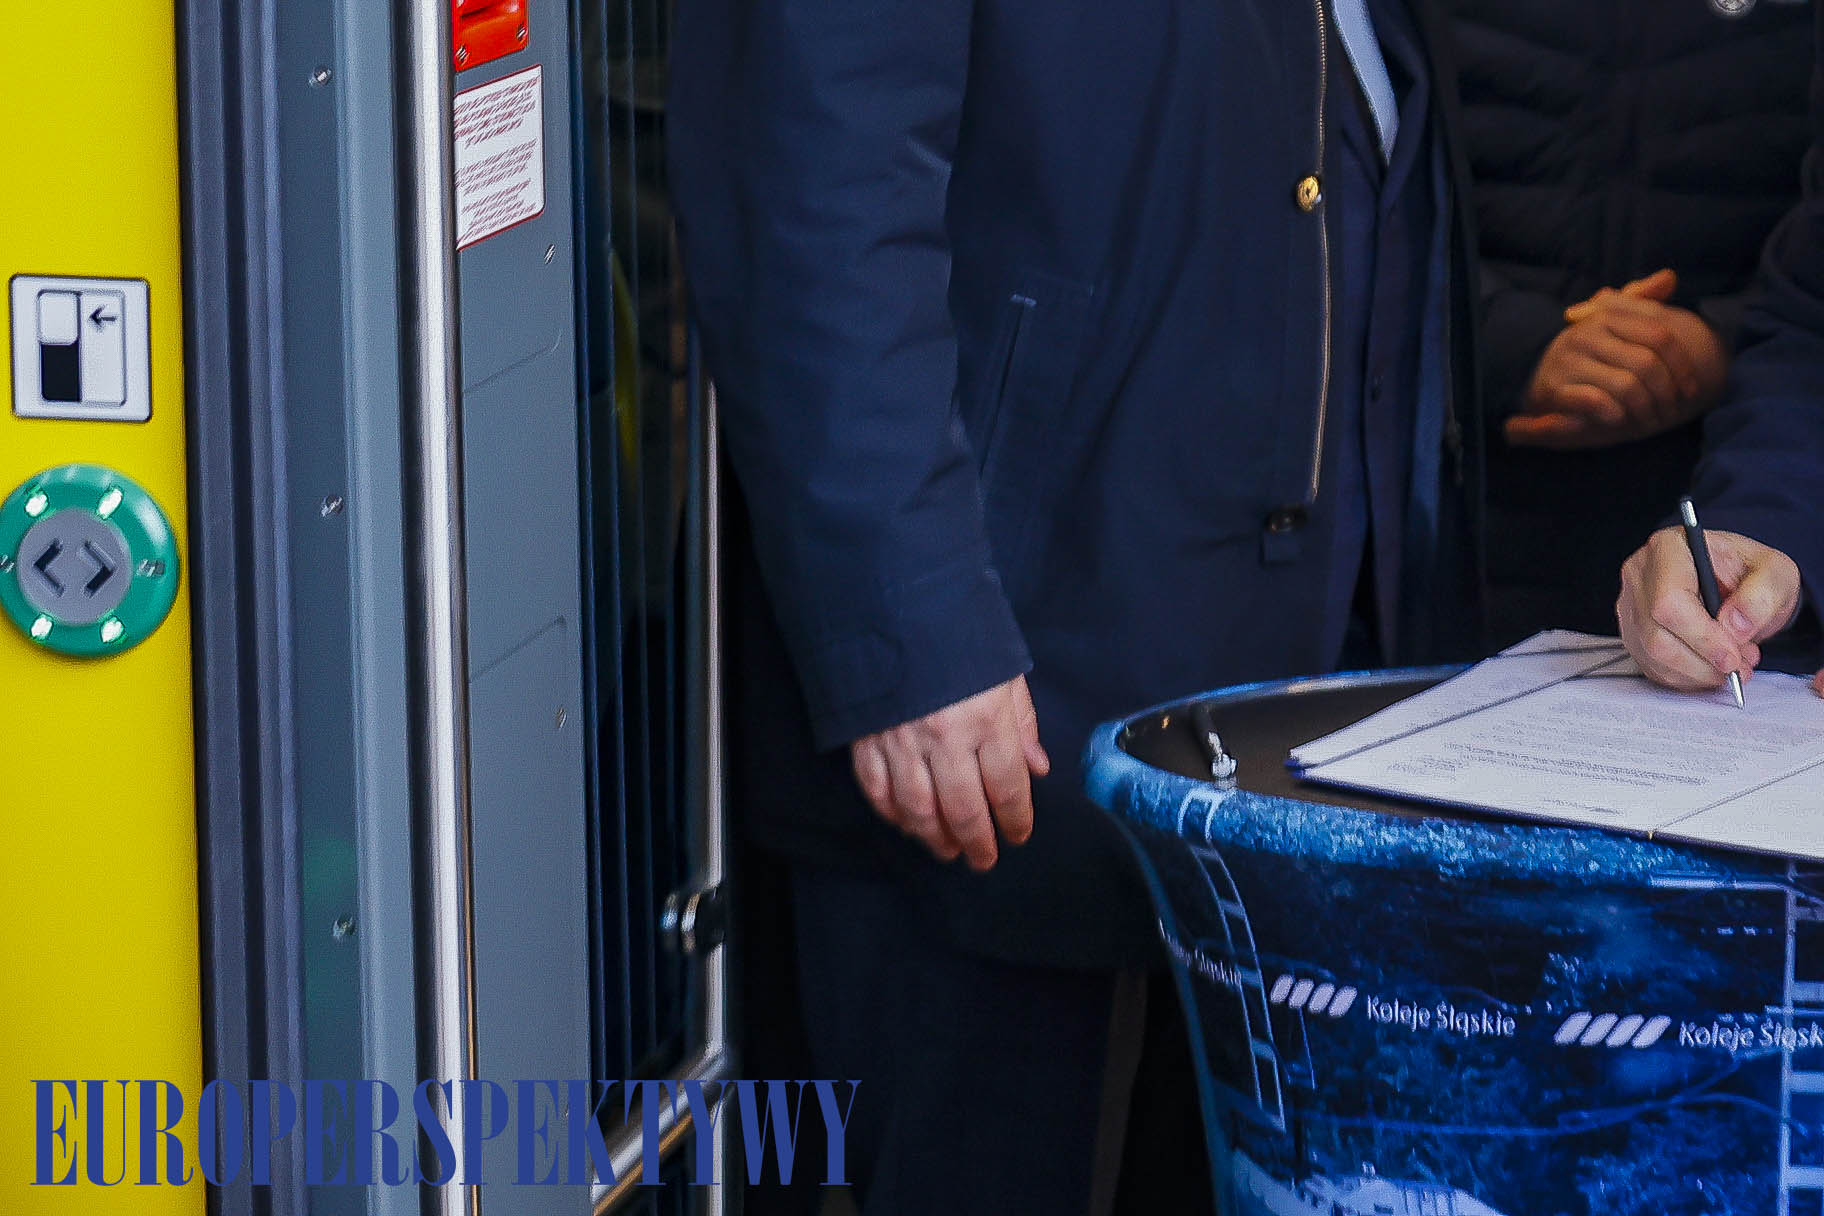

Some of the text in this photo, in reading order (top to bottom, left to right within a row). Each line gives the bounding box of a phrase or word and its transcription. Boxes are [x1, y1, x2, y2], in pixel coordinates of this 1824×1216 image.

[1366, 994, 1516, 1038] Koleje Śląskie
[1679, 1020, 1755, 1056] Koleje
